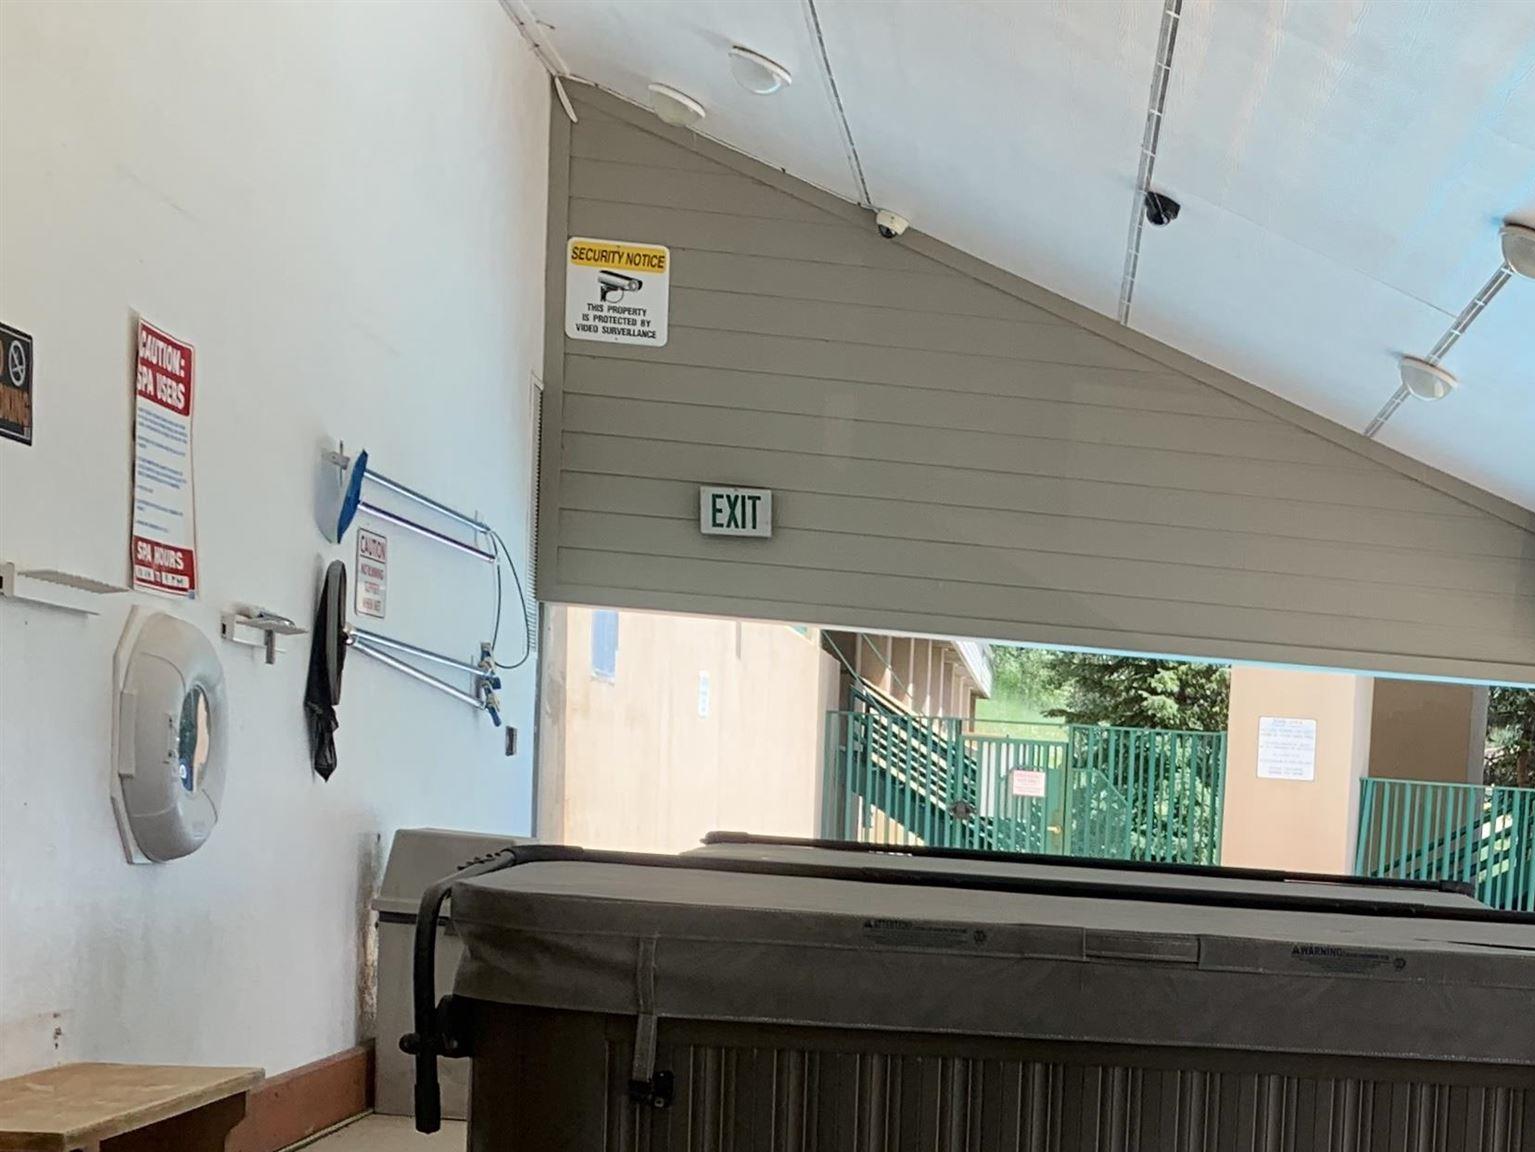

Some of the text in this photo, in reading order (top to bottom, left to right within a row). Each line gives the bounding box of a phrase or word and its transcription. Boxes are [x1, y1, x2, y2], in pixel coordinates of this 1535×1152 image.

[570, 246, 665, 269] SECURITY NOTICE
[587, 303, 647, 317] THIS PROPERTY
[582, 313, 652, 328] IS PROTECTED BY
[575, 323, 657, 339] VIDEO SURVEILLANCE
[712, 493, 761, 530] EXIT
